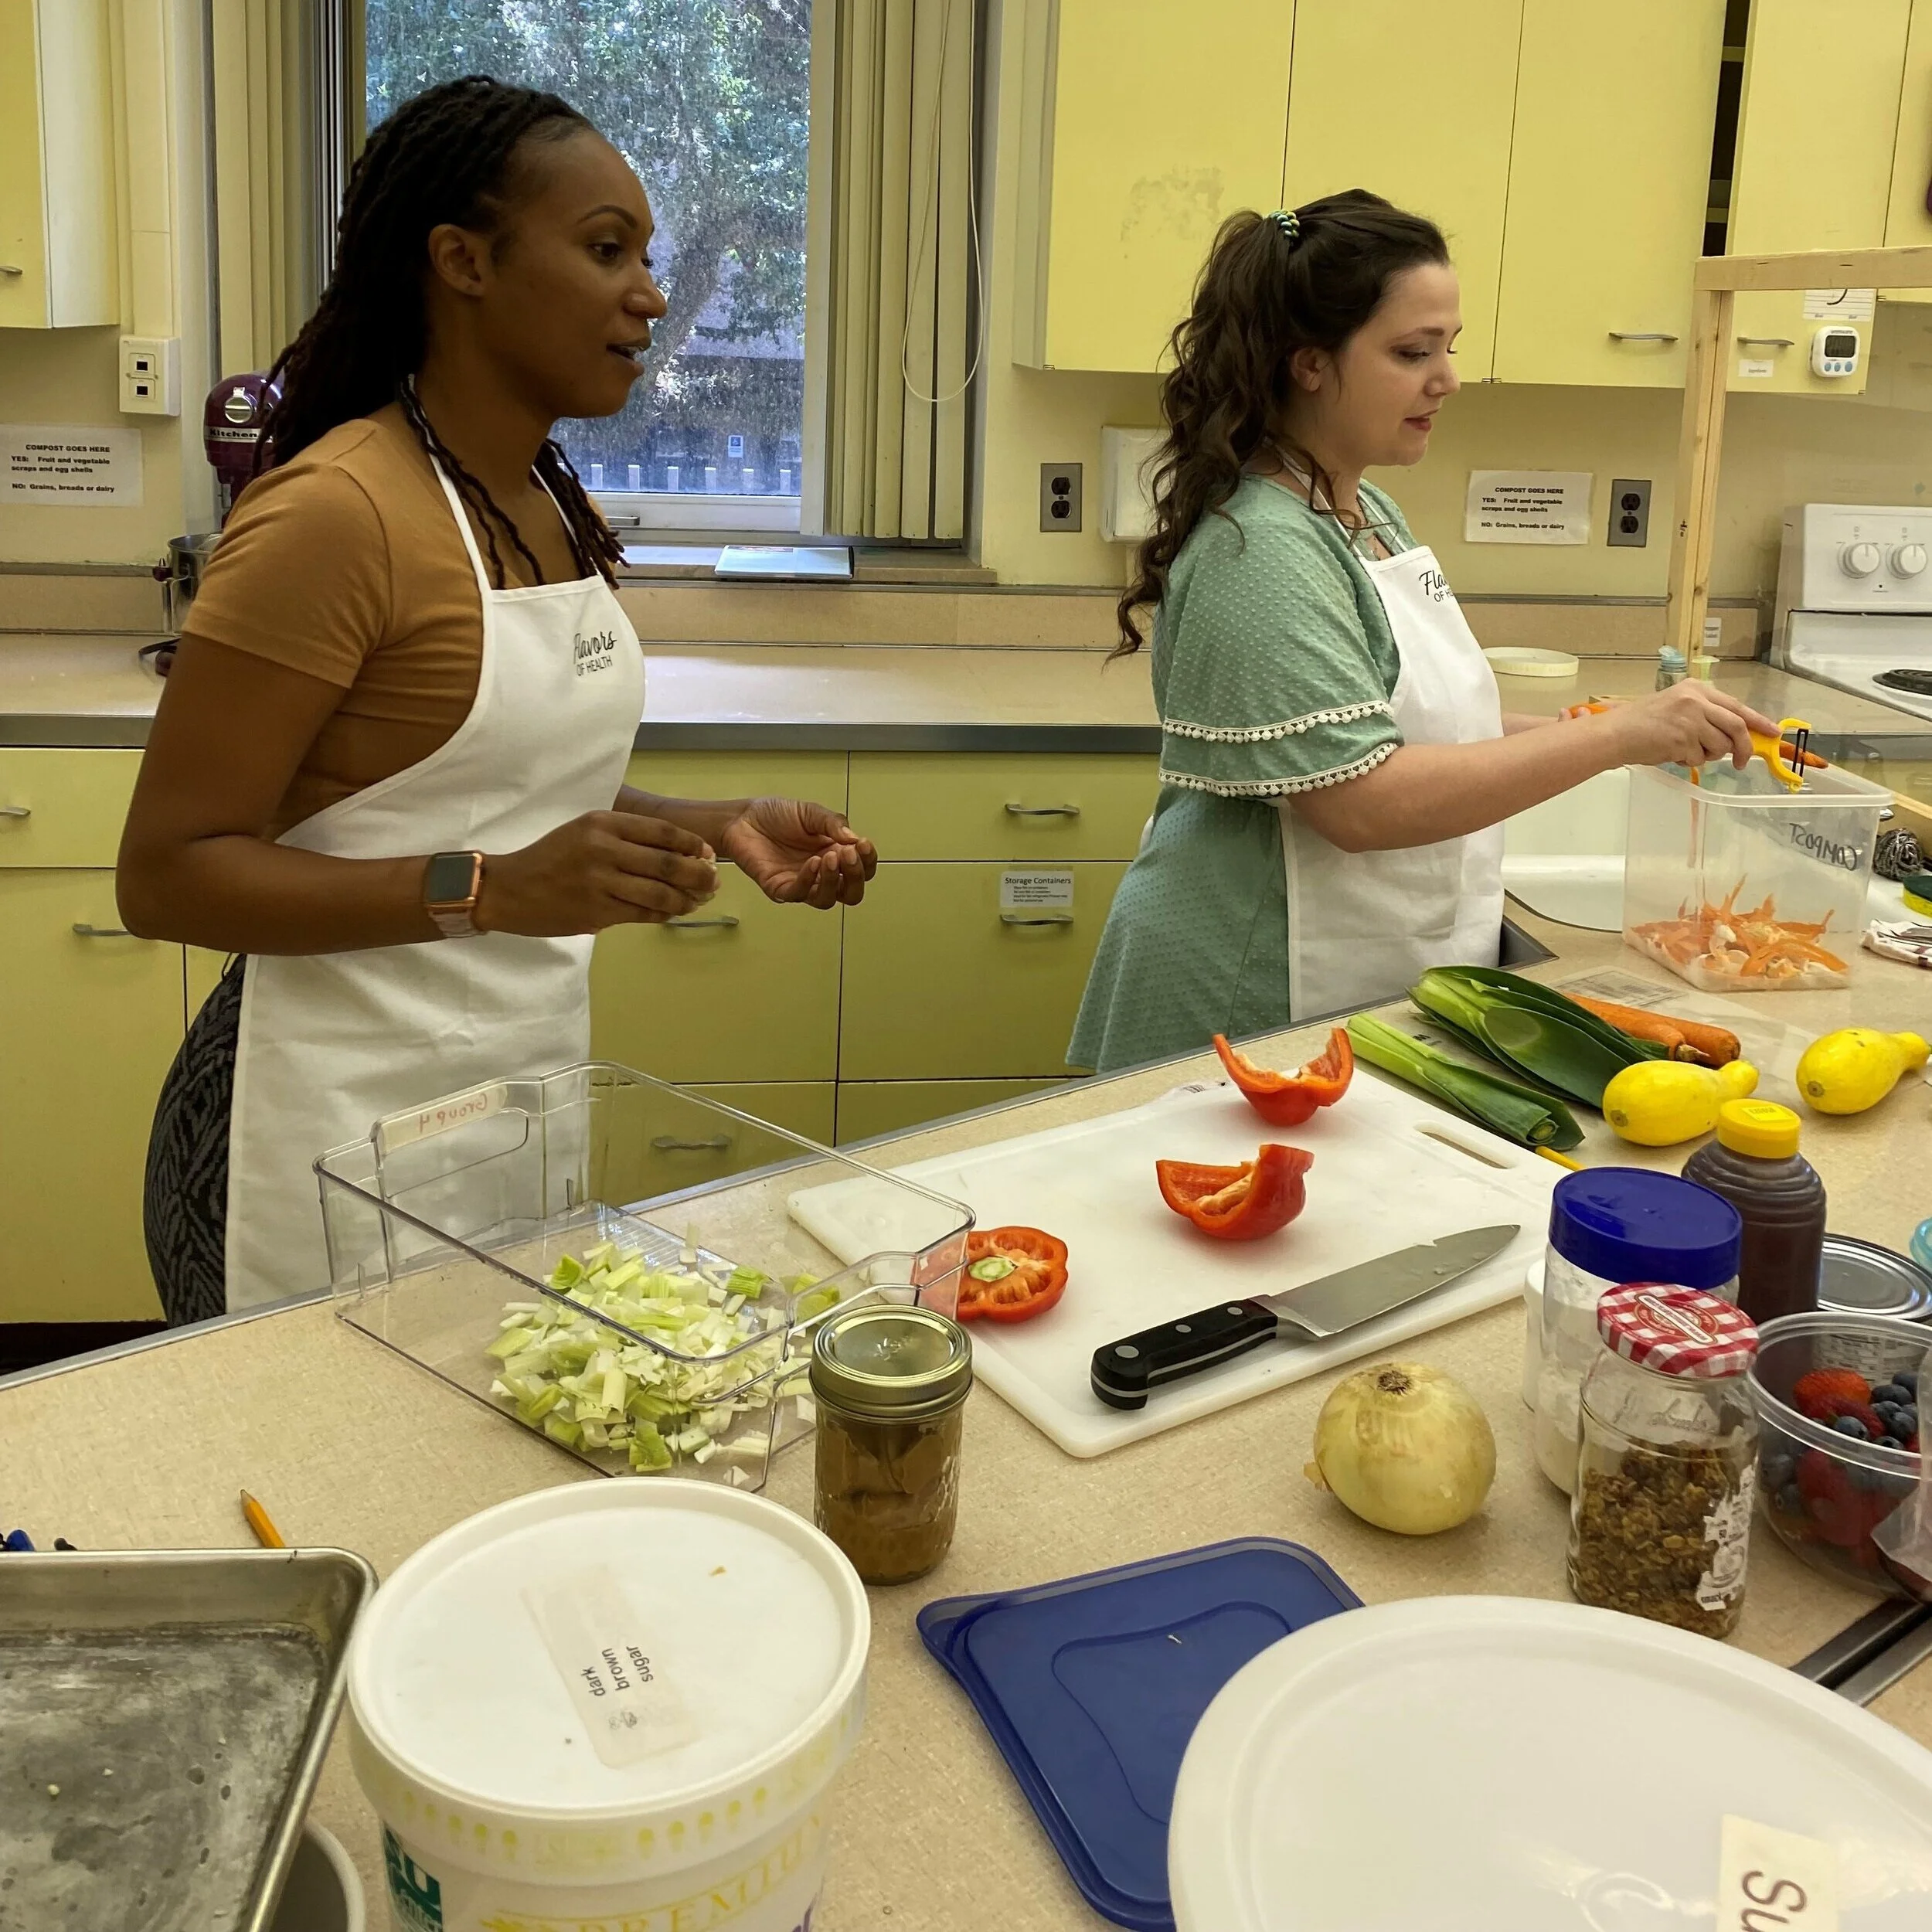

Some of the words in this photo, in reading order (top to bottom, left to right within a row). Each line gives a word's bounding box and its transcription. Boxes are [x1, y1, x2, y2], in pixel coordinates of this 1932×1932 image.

[1434, 590, 1444, 603] OF
[573, 631, 617, 665] Flavors
[576, 662, 585, 677] OF
[586, 655, 614, 674] HEALTH
[1005, 877, 1032, 886] Storage
[601, 1648, 631, 1692] brown
[625, 1645, 655, 1682] sugar
[580, 1666, 607, 1697] dark
